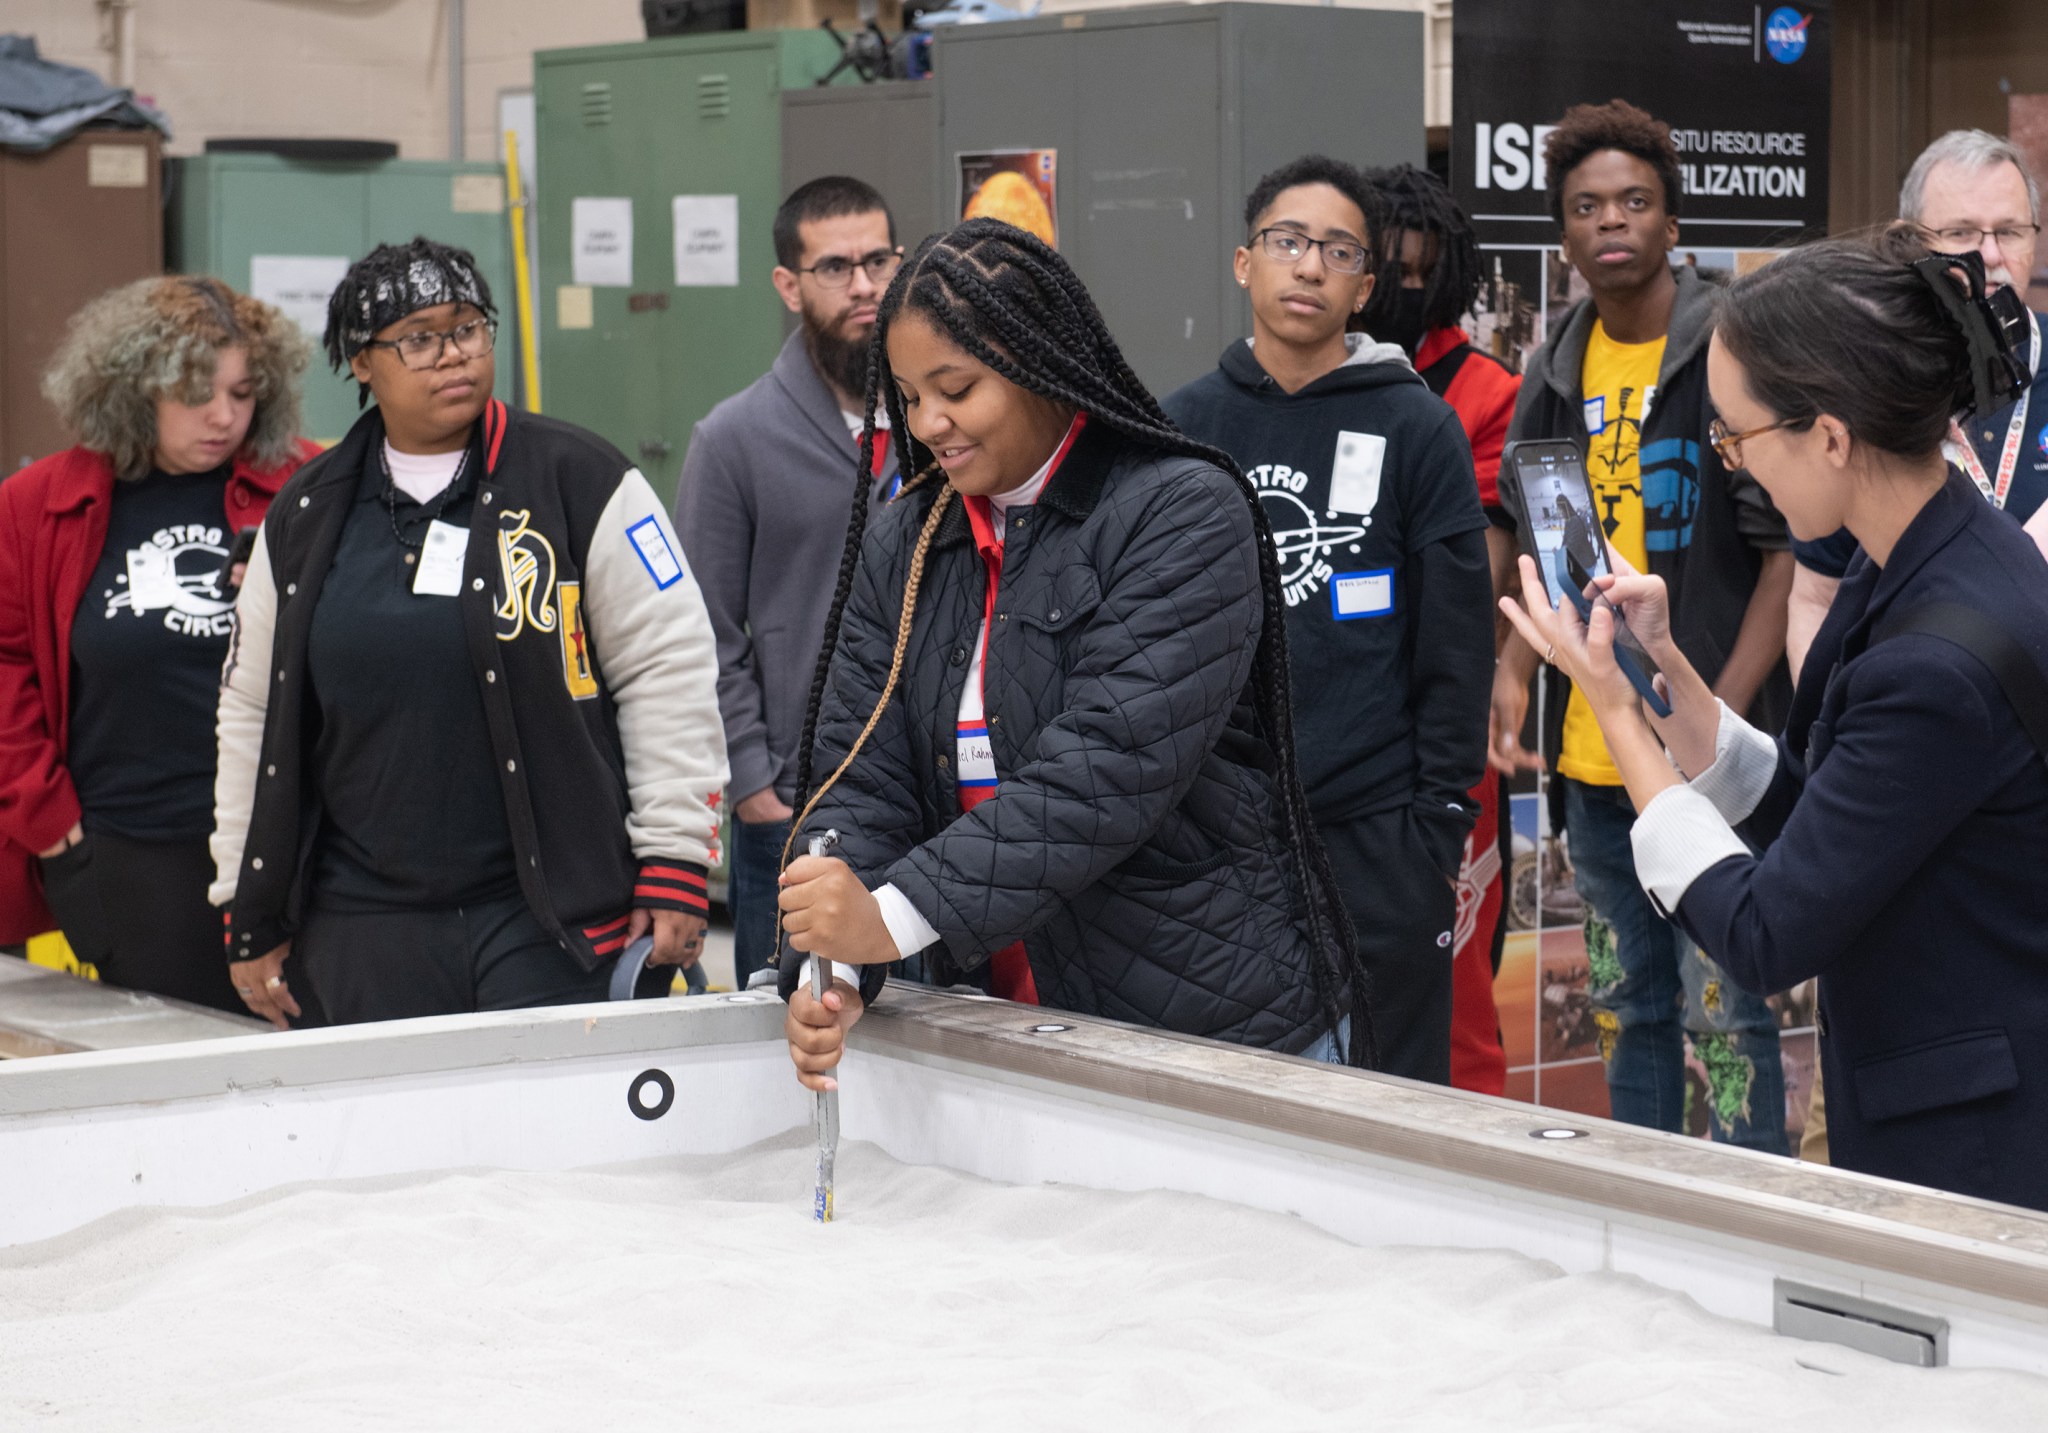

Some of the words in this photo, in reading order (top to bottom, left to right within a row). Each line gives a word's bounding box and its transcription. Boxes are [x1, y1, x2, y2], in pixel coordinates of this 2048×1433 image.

[1768, 27, 1806, 43] NASA
[1669, 128, 1710, 153] SITU
[1711, 129, 1806, 157] RESOURCE
[1677, 163, 1806, 198] ILIZATION
[1246, 464, 1309, 493] STRO
